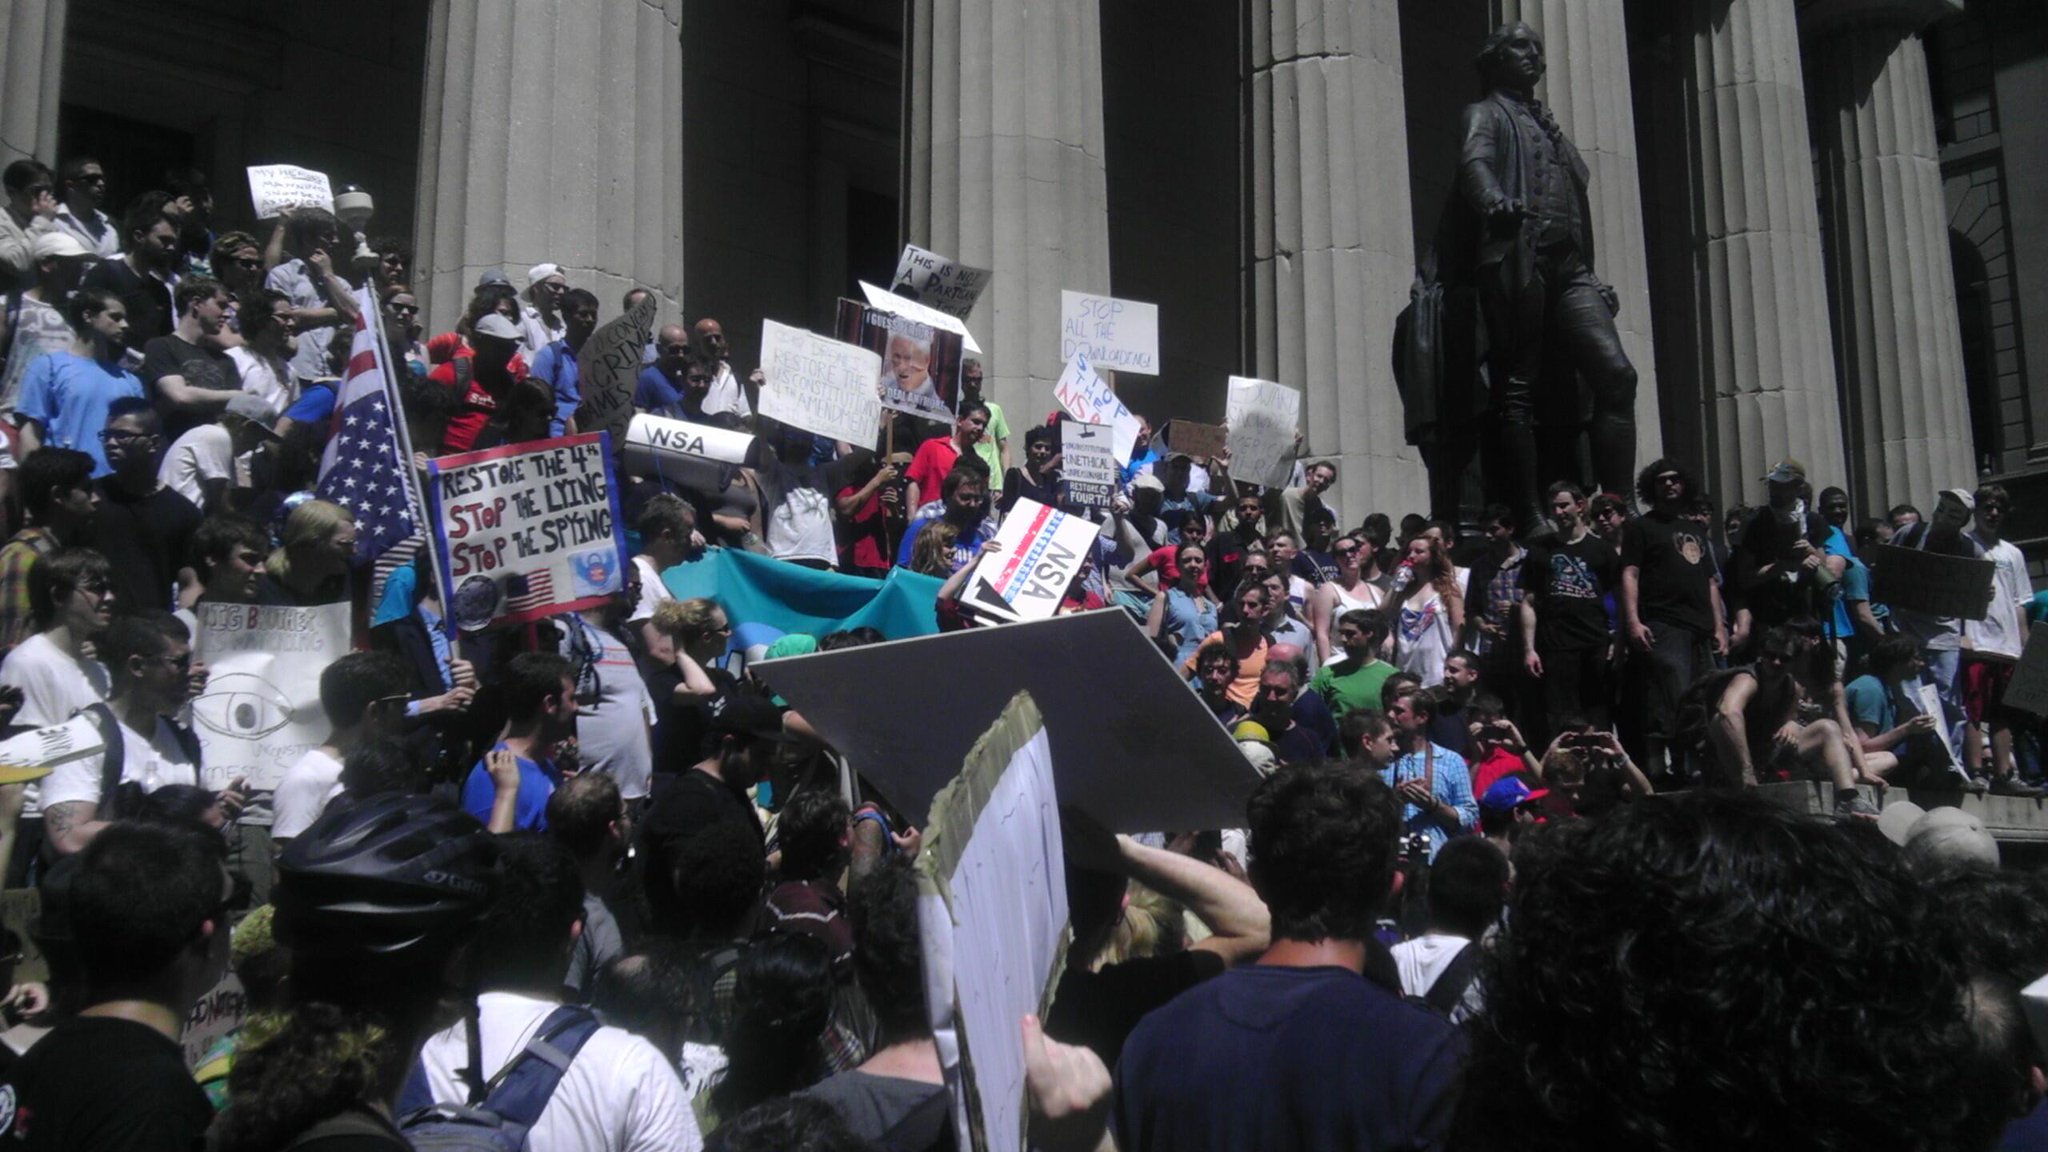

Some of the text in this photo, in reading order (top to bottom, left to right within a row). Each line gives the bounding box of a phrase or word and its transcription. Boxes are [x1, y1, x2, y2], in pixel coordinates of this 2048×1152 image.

[903, 268, 913, 283] A
[908, 247, 981, 281] THIS IS NOT
[1079, 298, 1124, 319] STOP
[1065, 318, 1117, 341] ALL THE
[774, 349, 868, 395] RESTORE THE
[443, 460, 525, 500] RESTORE
[530, 450, 567, 478] THE
[1066, 454, 1110, 470] UNETHICAL
[1070, 481, 1099, 493] RESTORE
[1070, 491, 1111, 506] FOURTH
[450, 472, 608, 539] STOP THE LYING
[452, 509, 612, 576] STOP THE SPYING
[1022, 541, 1076, 600] NSA
